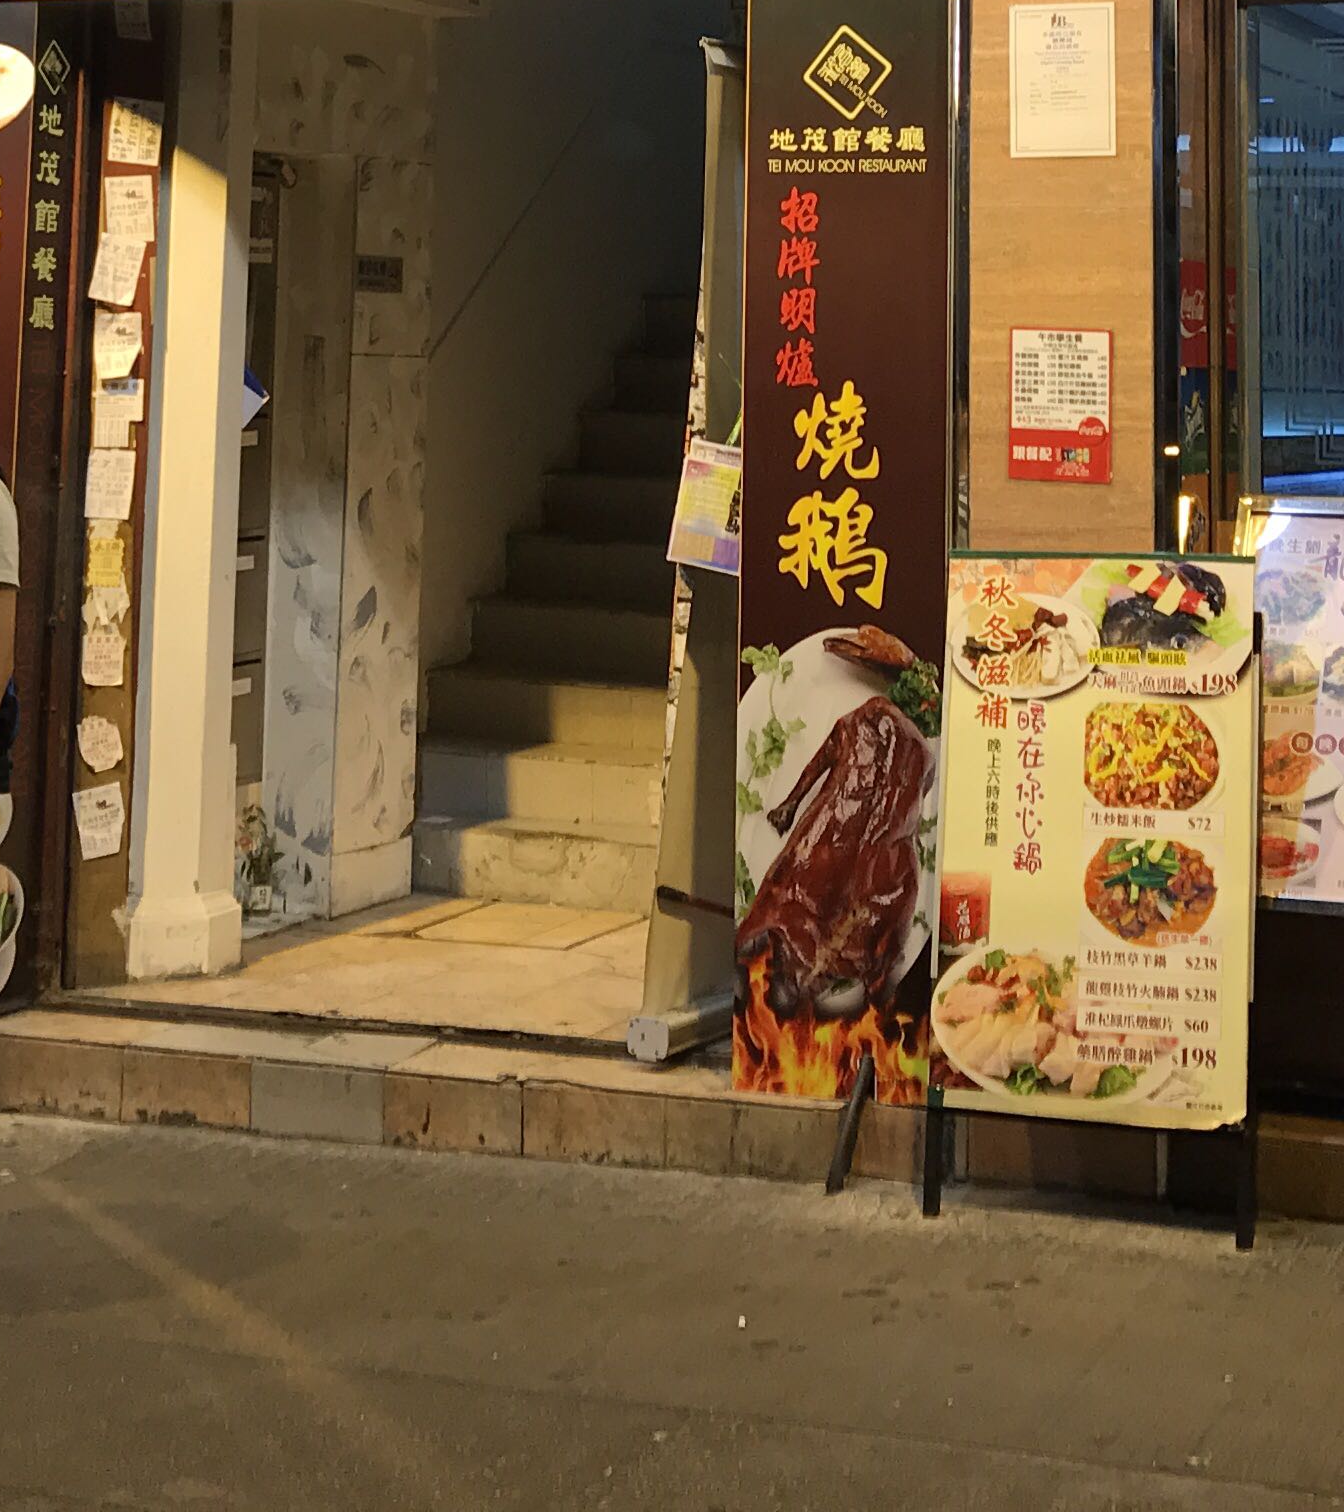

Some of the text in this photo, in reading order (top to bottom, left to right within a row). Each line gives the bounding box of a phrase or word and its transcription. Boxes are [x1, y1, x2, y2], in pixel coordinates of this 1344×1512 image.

[769, 125, 926, 154] 地茂館餐廳
[768, 158, 927, 173] TEI MOU KOON RESTAURANT
[29, 103, 64, 331] 地茂館餐廳
[976, 575, 1017, 730] 秋冬滋補
[1191, 673, 1238, 694] $198
[984, 738, 1002, 847] 晚上六時後供應
[1090, 811, 1156, 829] 生炒糯米飯
[1187, 816, 1212, 832] $72
[1185, 956, 1218, 972] $238
[1184, 987, 1217, 1004] $238
[1184, 1019, 1209, 1034] $60
[1171, 1047, 1218, 1070] $198
